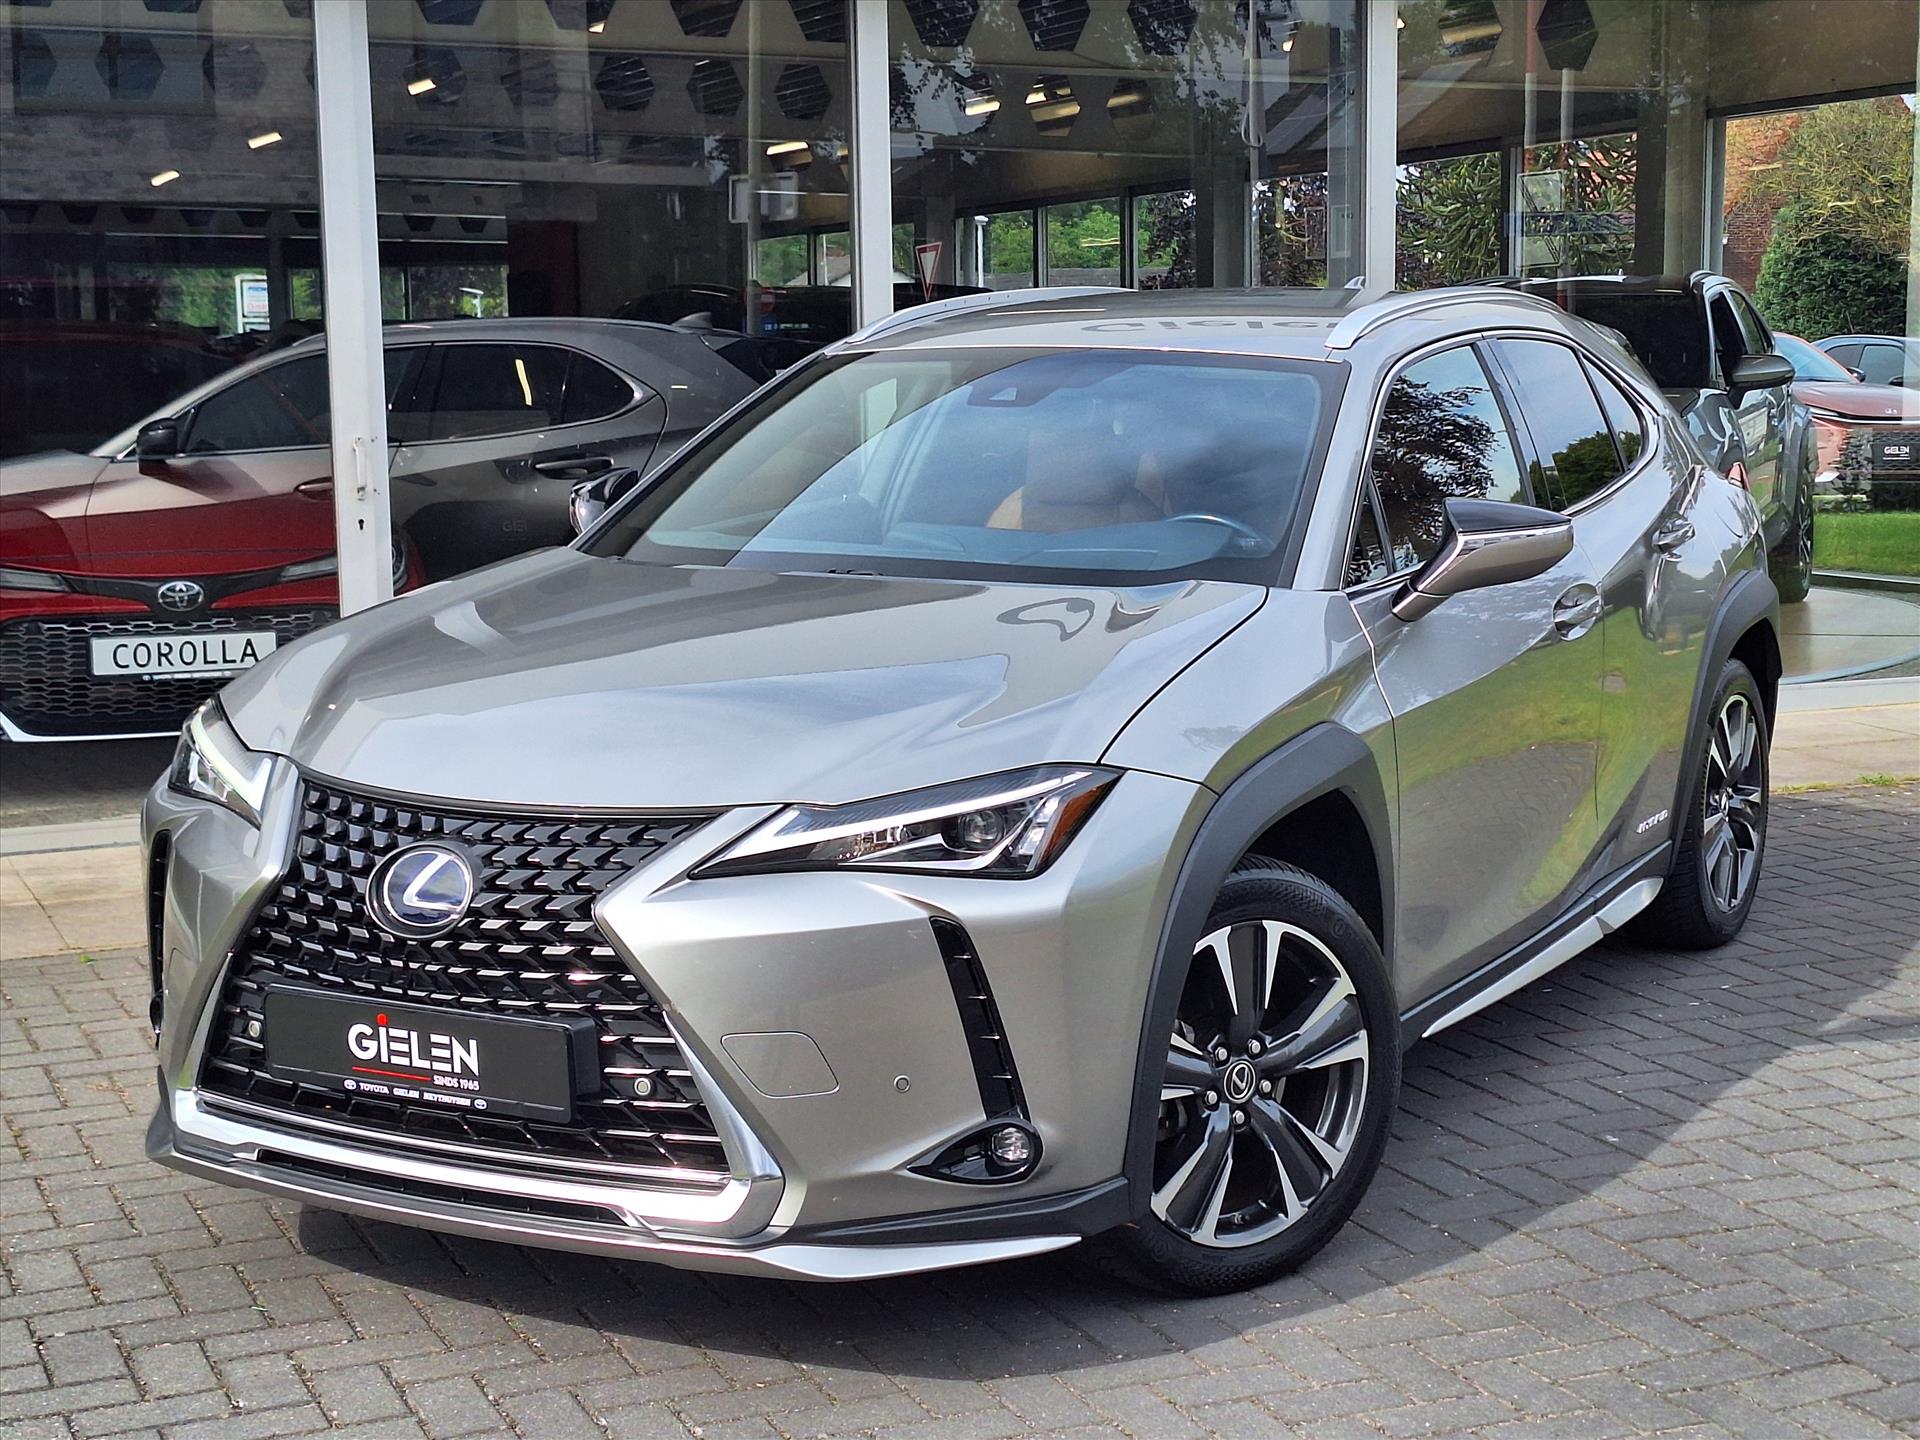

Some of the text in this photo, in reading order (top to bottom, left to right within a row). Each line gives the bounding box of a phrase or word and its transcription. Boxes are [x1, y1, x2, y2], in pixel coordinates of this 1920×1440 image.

[112, 637, 260, 669] COROLLA
[347, 1013, 480, 1077] GIELEN
[359, 1082, 390, 1095] TOYOTA
[433, 1075, 480, 1091] SINDS 1965
